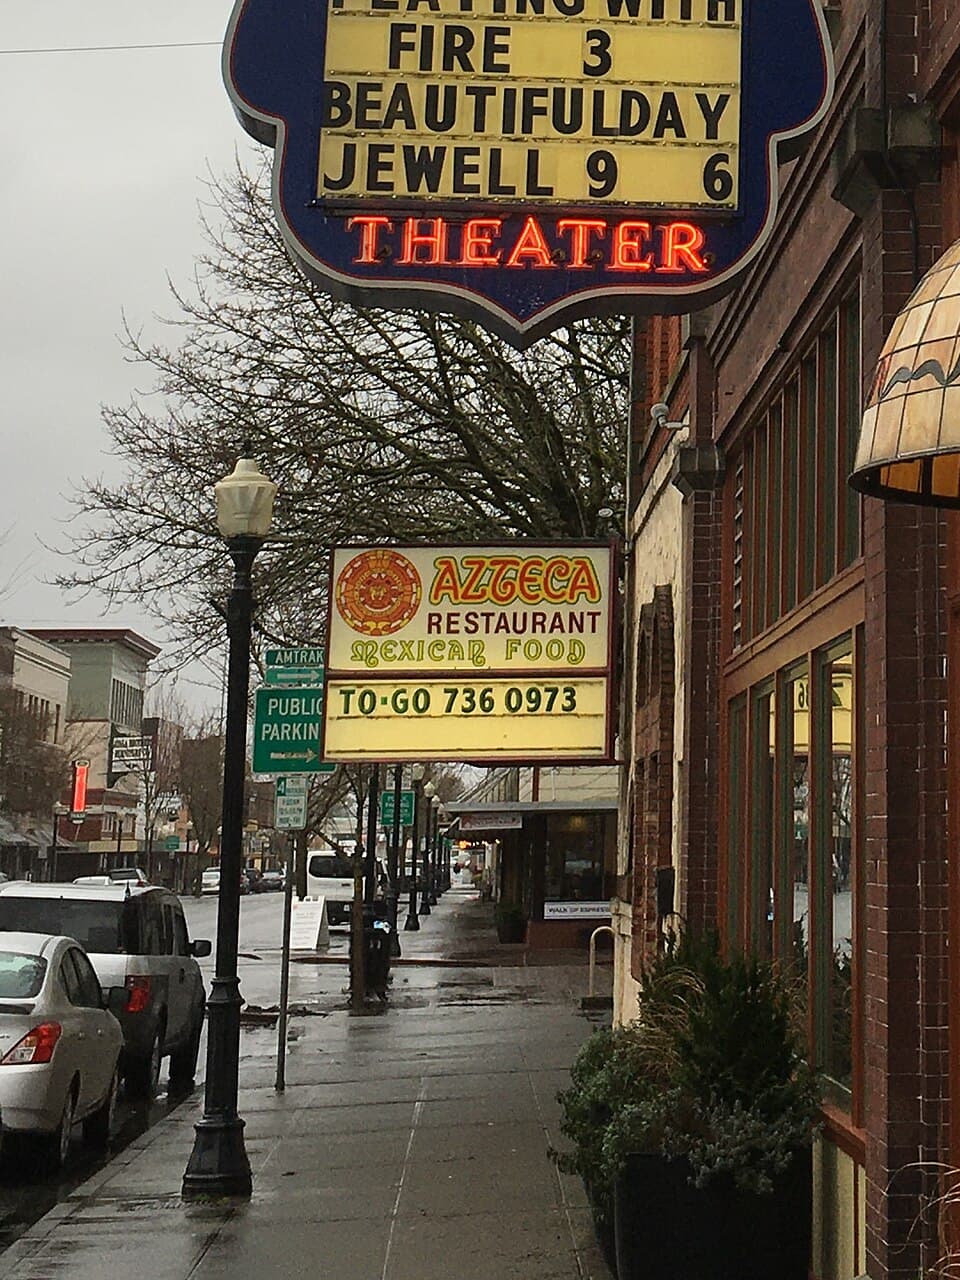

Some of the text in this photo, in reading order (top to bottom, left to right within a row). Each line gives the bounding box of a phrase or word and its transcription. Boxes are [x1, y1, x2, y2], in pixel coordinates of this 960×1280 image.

[388, 22, 613, 77] FIRE 3
[323, 143, 734, 202] JEWELL 9 6
[347, 216, 711, 273] THEATER
[429, 554, 601, 606] AZTECA
[427, 610, 602, 635] RESTAURANT
[275, 650, 324, 664] AMTRAK
[350, 638, 587, 669] MEXICAN FOOD
[443, 686, 495, 715] 736
[504, 686, 577, 714] 0973
[260, 722, 320, 742] PARKIN
